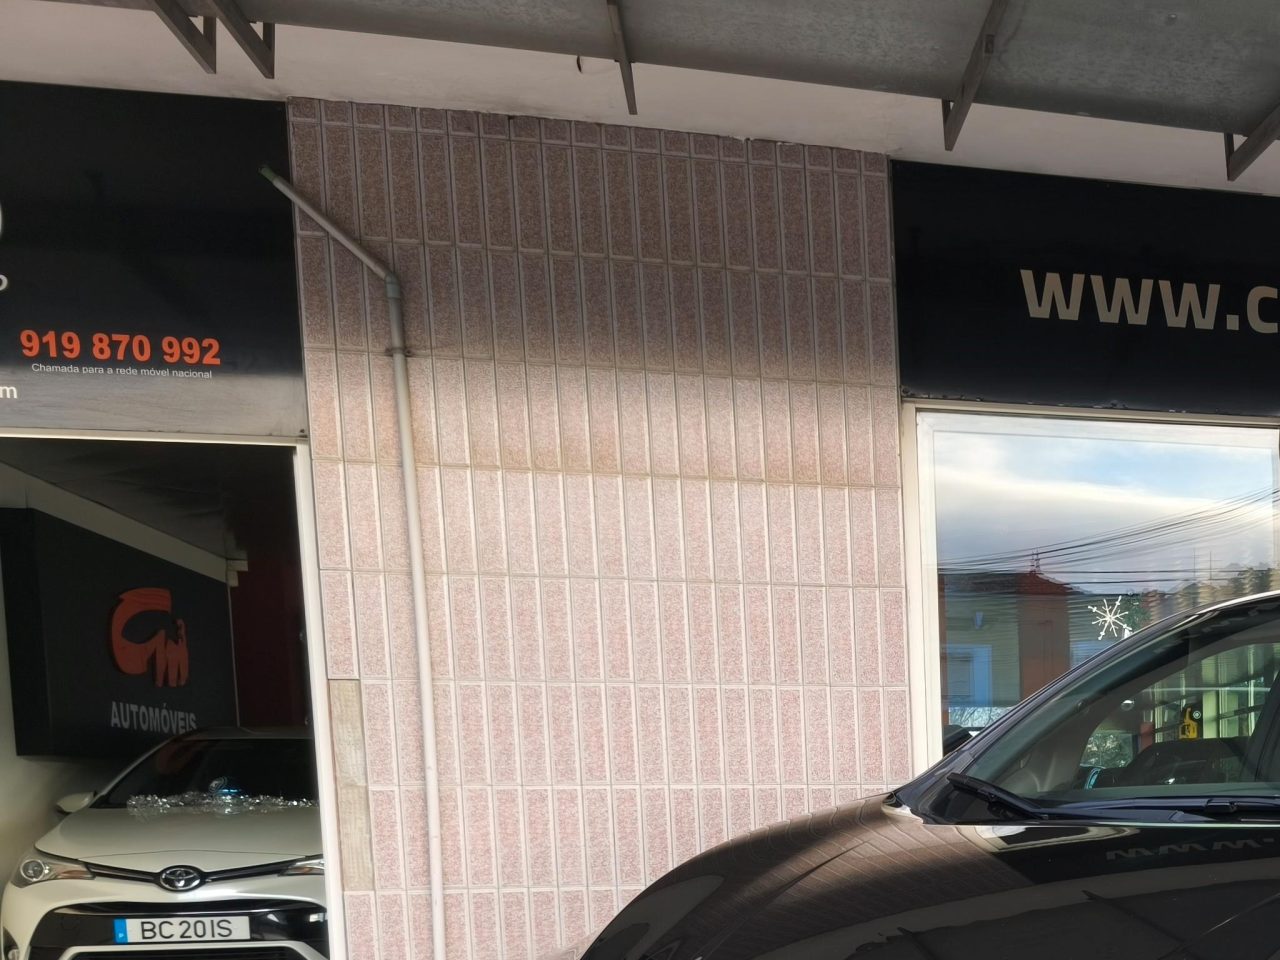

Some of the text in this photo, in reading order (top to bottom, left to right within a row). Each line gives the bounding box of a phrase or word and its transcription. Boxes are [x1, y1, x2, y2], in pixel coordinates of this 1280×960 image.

[19, 329, 221, 365] 919 870 992
[31, 363, 80, 374] Chamada
[82, 366, 104, 375] para
[116, 367, 138, 376] rede
[140, 367, 170, 378] móvel
[172, 368, 213, 379] nacional
[111, 701, 197, 734] AUTOMÓVEIS
